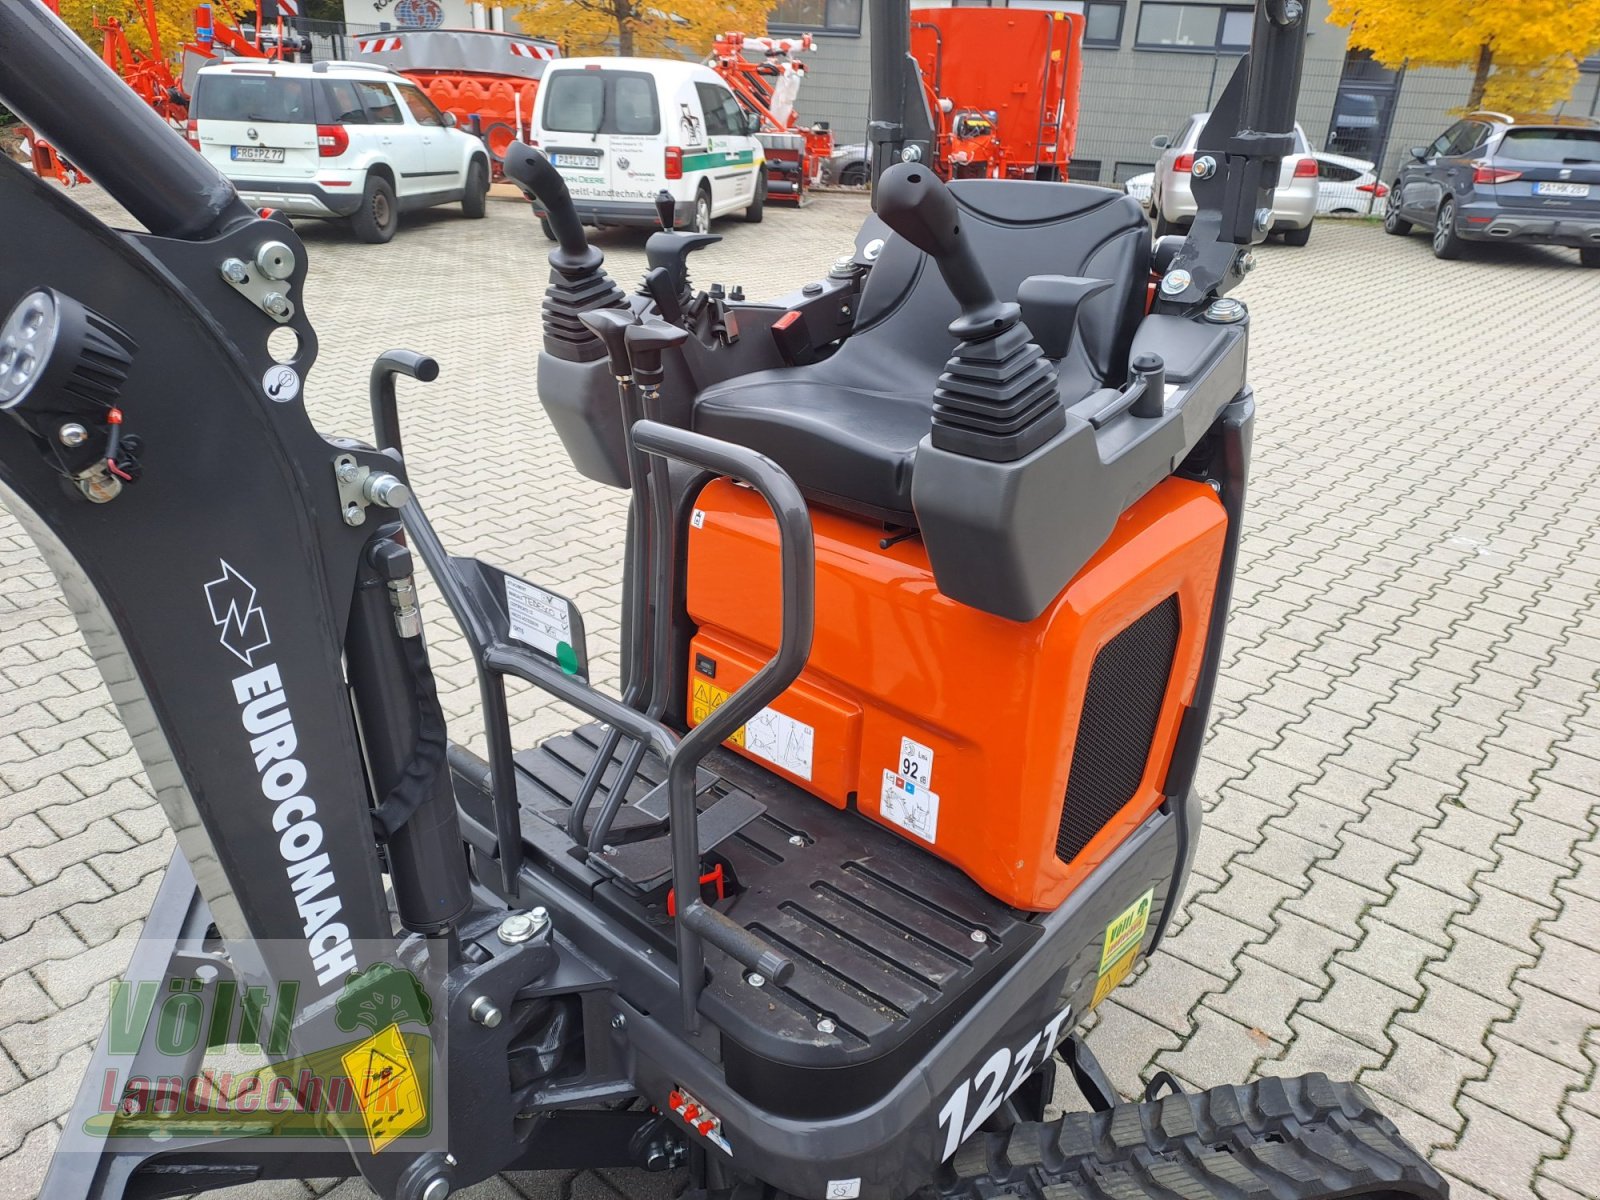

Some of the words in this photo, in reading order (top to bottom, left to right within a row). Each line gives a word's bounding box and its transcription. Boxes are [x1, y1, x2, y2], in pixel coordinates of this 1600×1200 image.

[236, 147, 253, 158] FRG
[259, 149, 270, 159] PZ
[271, 149, 283, 159] 77
[567, 187, 658, 199] oeltl-landtechnik.de
[903, 758, 918, 779] 92
[232, 662, 357, 987] EUROCOMACH
[939, 1004, 1071, 1164] 12ZT
